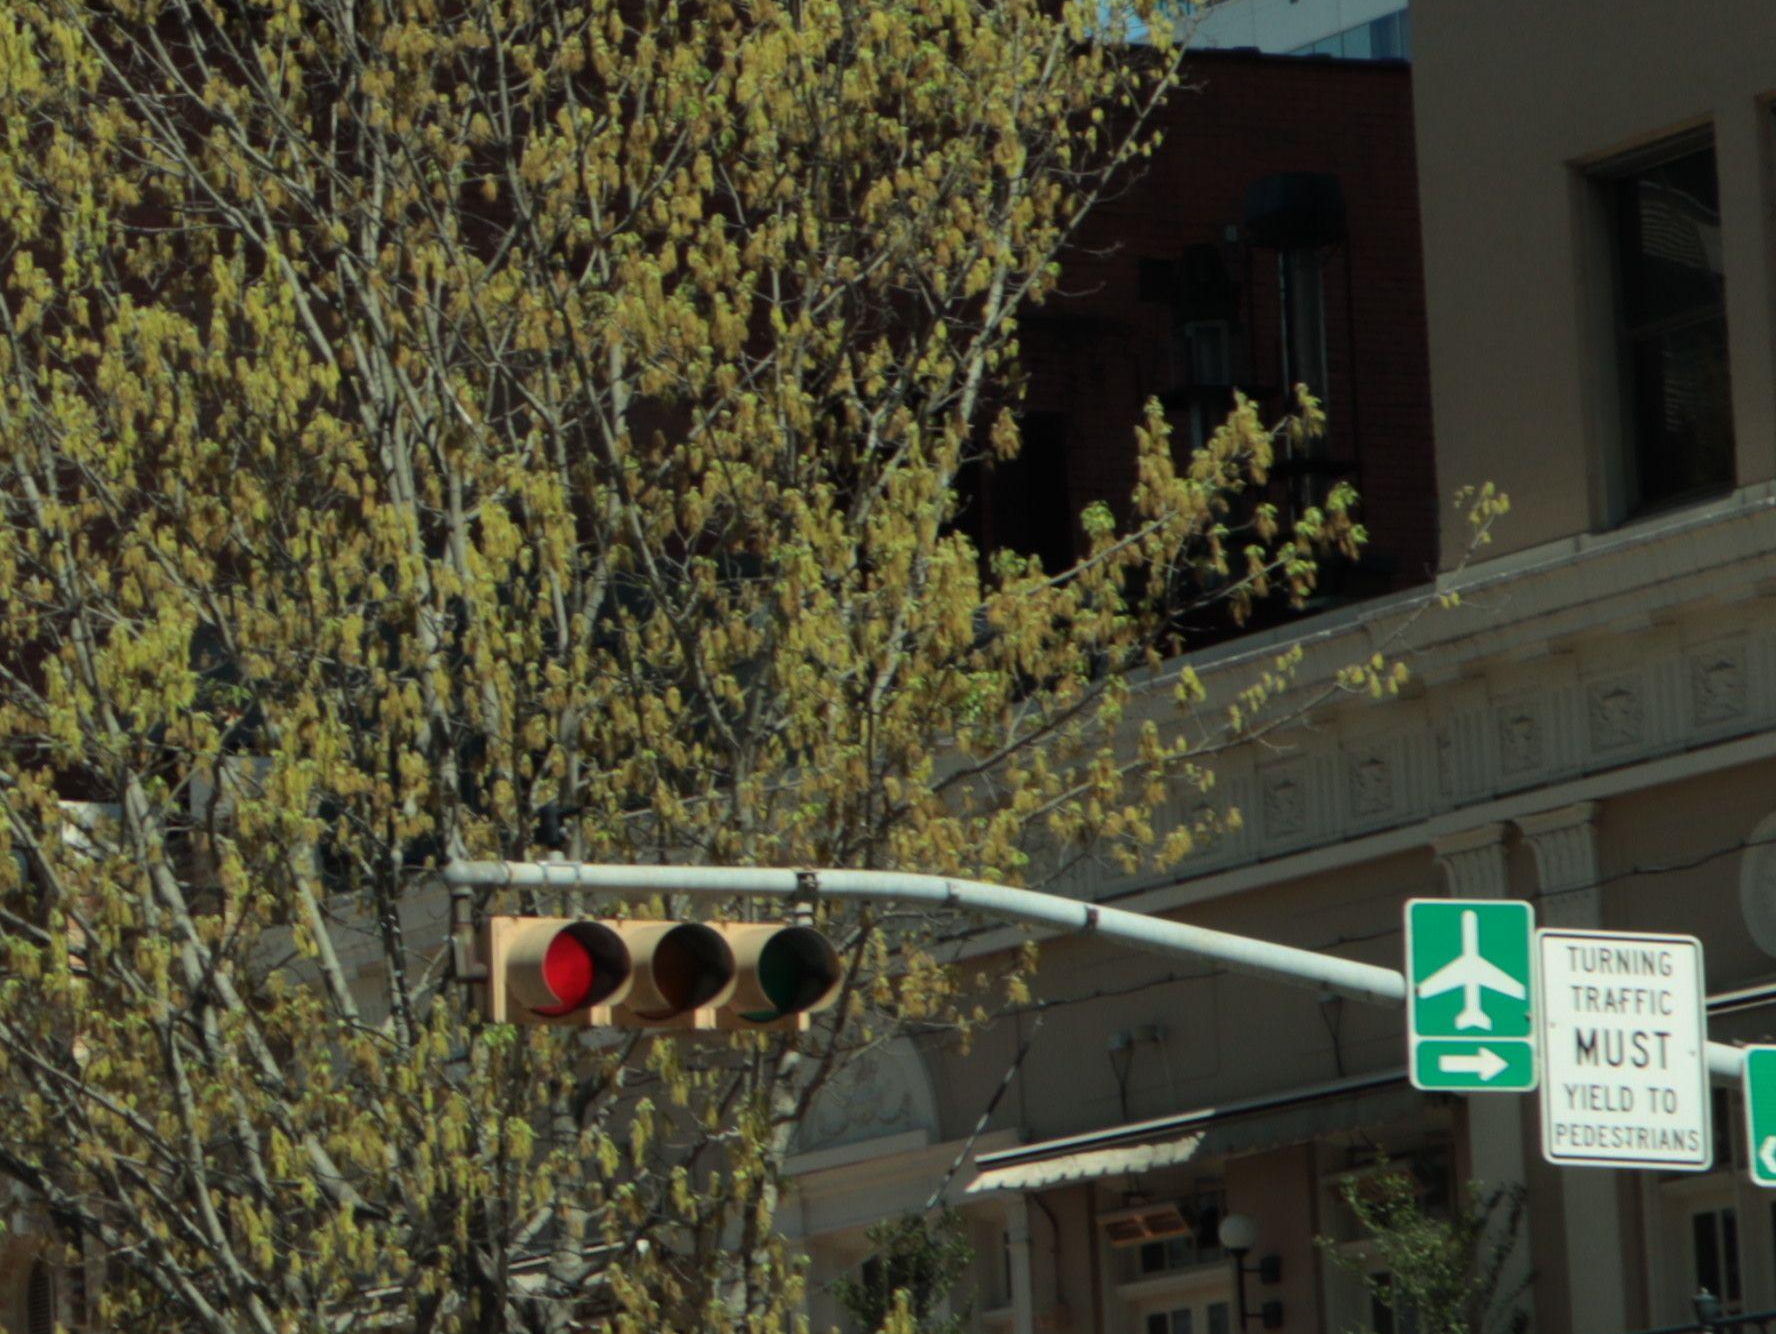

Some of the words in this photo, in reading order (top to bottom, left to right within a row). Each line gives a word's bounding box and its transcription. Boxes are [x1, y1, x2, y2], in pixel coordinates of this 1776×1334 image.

[1566, 945, 1674, 977] TURNING
[1569, 985, 1674, 1016] TRAFFIC
[1574, 1028, 1672, 1069] MUST
[1563, 1083, 1634, 1112] YIELD
[1647, 1086, 1678, 1114] TO
[1554, 1124, 1700, 1152] PEDESTRIANS
